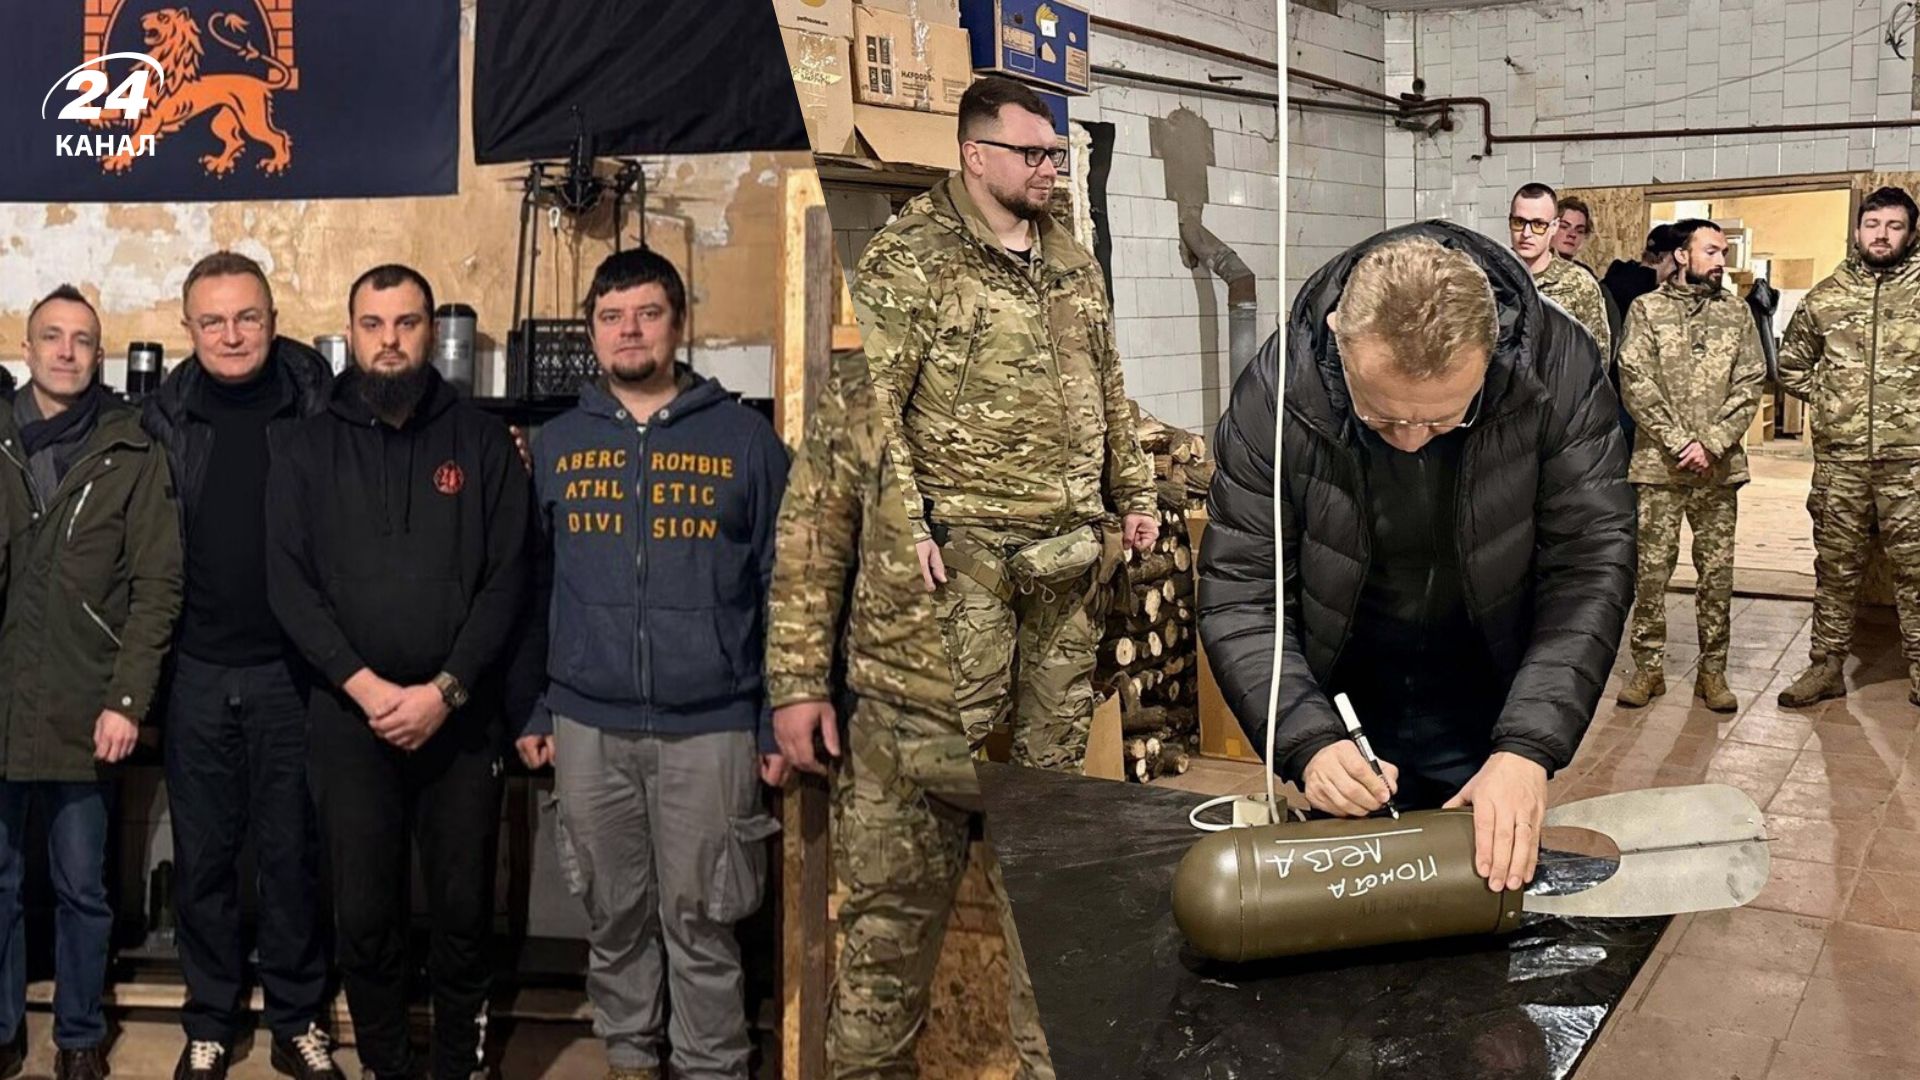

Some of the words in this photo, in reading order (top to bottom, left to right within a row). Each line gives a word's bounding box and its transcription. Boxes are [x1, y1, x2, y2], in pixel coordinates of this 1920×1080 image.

[555, 449, 627, 474] ABERC
[651, 452, 733, 478] ROMBIE
[565, 479, 625, 501] ATHL
[652, 482, 716, 506] ETIC
[567, 512, 623, 535] DIVI
[652, 516, 718, 540] SION
